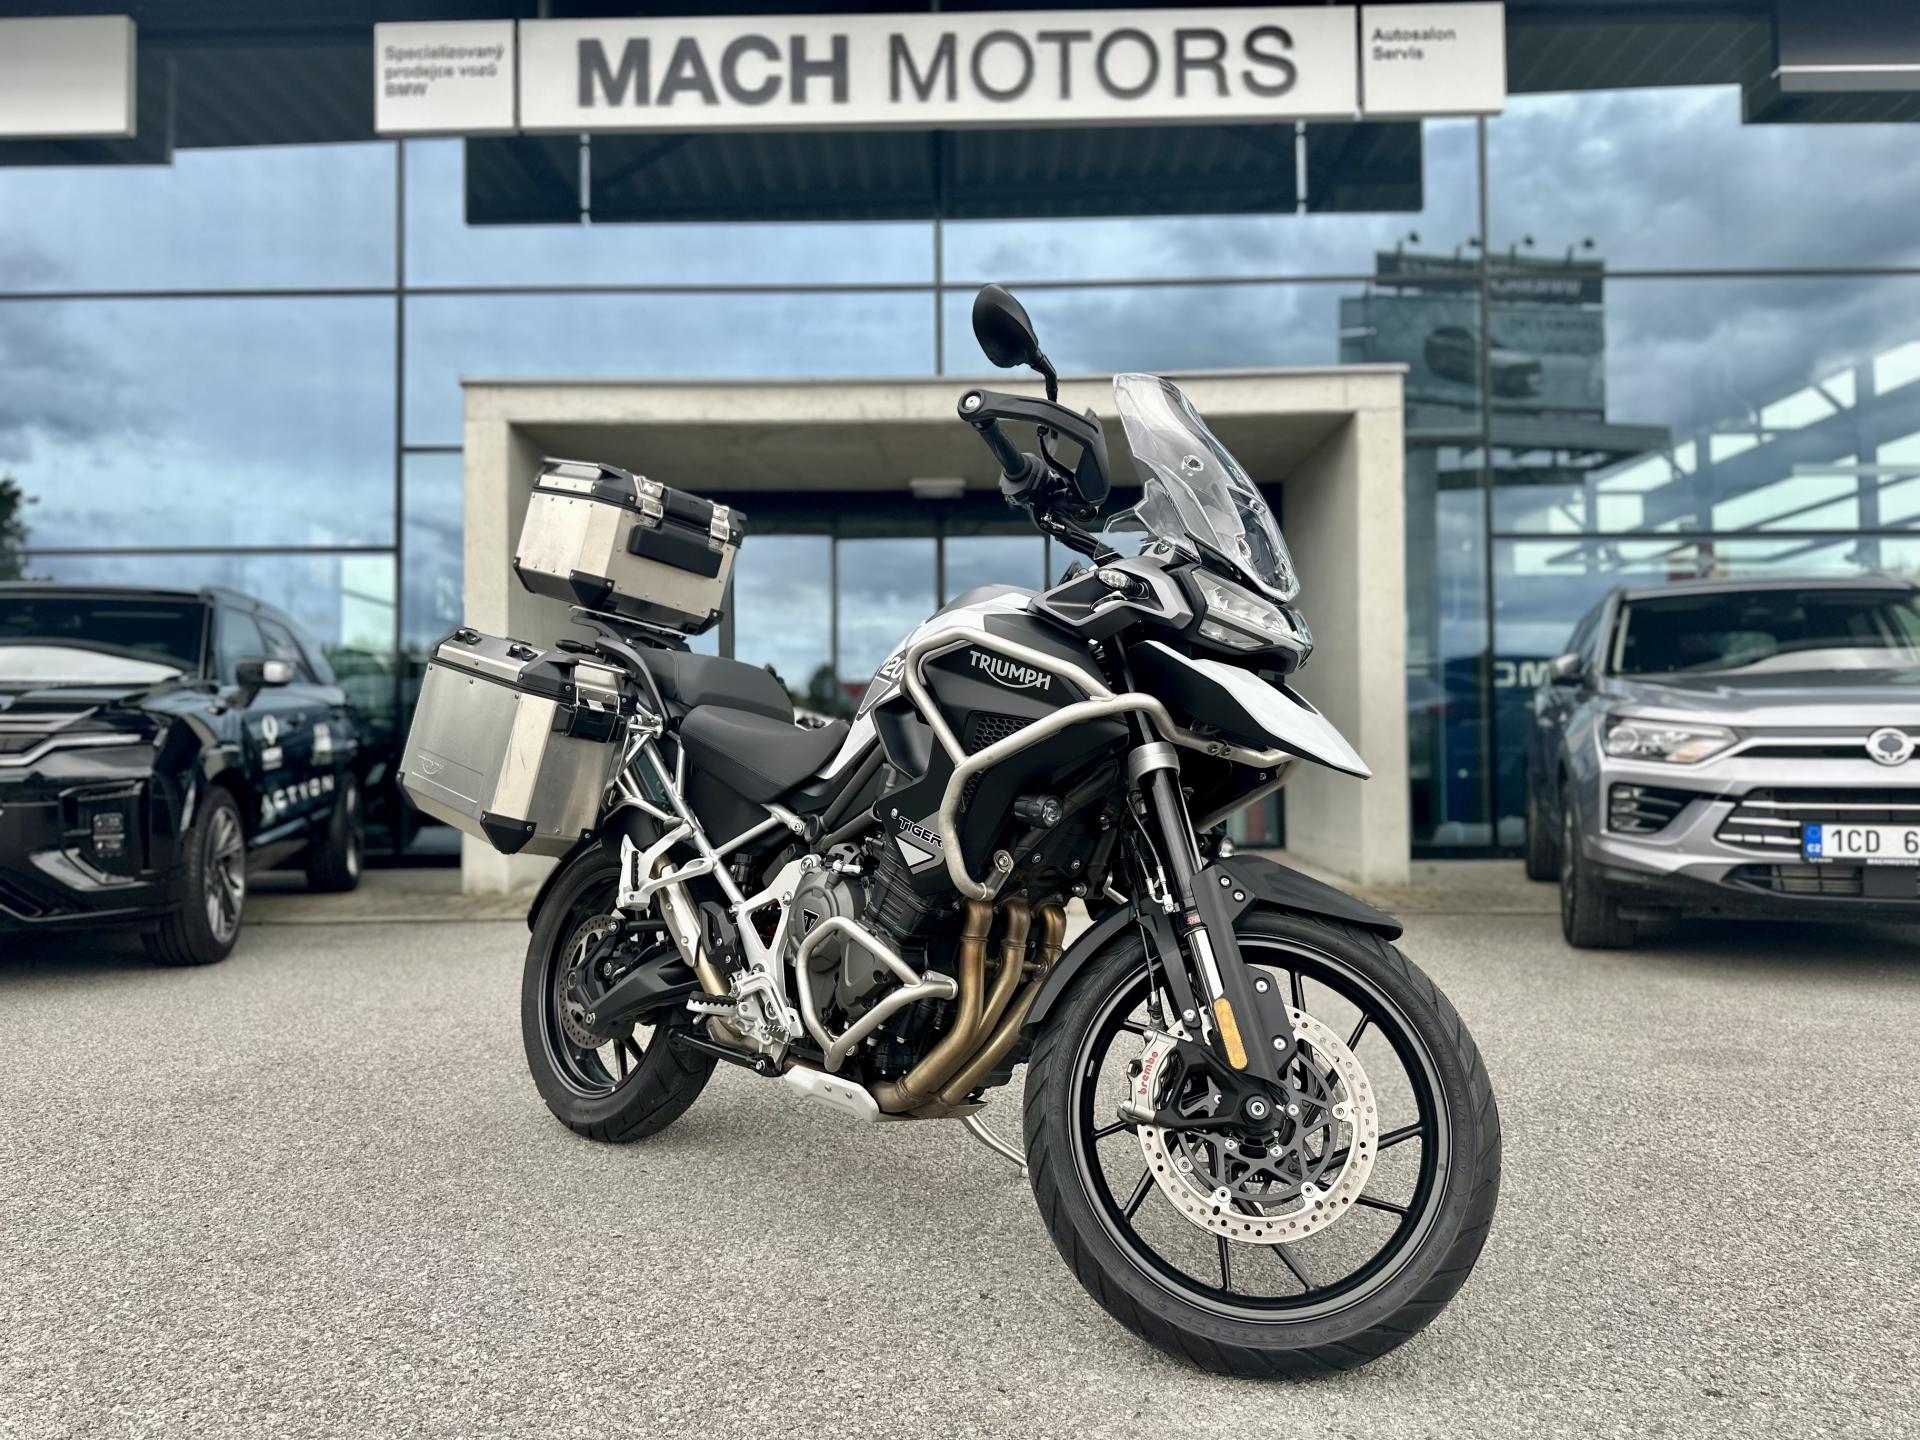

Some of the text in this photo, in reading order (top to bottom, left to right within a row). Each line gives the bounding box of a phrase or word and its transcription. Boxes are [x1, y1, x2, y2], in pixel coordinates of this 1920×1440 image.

[1373, 25, 1455, 42] Autosalon
[577, 25, 1296, 108] MACH MOTORS
[1373, 46, 1424, 61] Servis
[969, 650, 1052, 690] TRIUMPH
[899, 815, 943, 850] TIGER
[1832, 829, 1880, 853] 1CD
[1138, 1051, 1159, 1095] brembo
